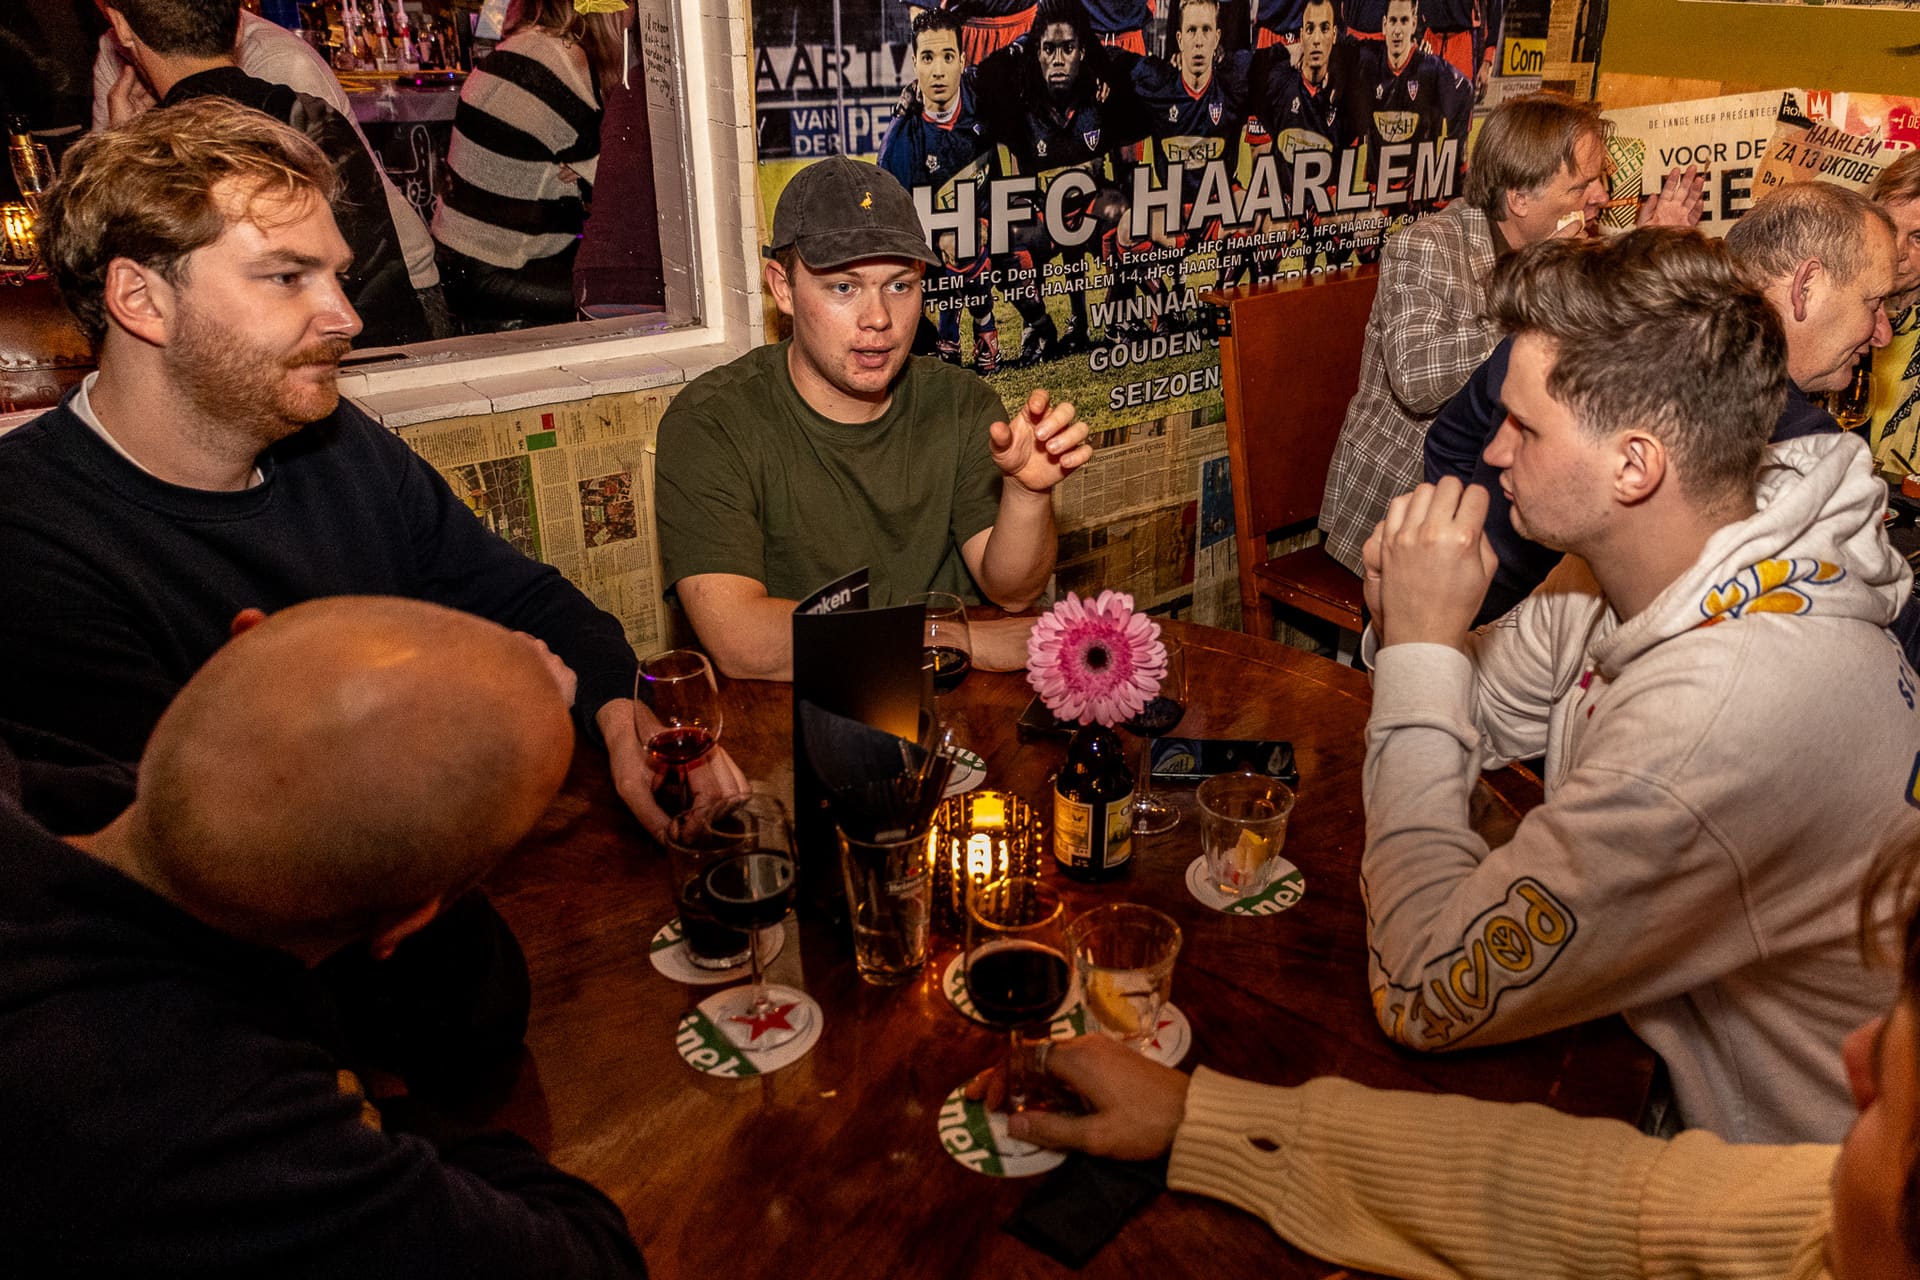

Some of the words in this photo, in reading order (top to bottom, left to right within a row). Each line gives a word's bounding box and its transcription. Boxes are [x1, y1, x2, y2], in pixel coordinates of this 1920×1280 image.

[793, 108, 838, 131] VAN
[1659, 142, 1727, 167] VOOR
[1774, 141, 1797, 164] ZA
[1798, 147, 1821, 169] 13
[1804, 124, 1882, 160] HAARLEM
[912, 170, 1098, 260] HFC
[1131, 138, 1458, 237] HAARLEM
[980, 270, 1002, 286] FC
[1007, 267, 1038, 282] Den
[1042, 257, 1090, 277] Bosch
[1122, 246, 1187, 266] Excelsior
[1197, 239, 1224, 255] HFC
[1226, 230, 1287, 250] HAARLEM
[1313, 224, 1337, 238] HFC
[1340, 215, 1393, 234] HAARLEM
[1401, 213, 1415, 225] Go
[926, 293, 989, 314] Telstar
[1003, 284, 1036, 302] HFC
[1040, 273, 1116, 298] HAARLEM
[1147, 263, 1176, 280] HFC
[1178, 254, 1242, 275] HAARLEM
[1252, 249, 1278, 263] VVV
[1281, 243, 1312, 258] Venlo
[1339, 235, 1380, 251] Fortuna
[1089, 331, 1202, 372] GOUDEN
[1109, 364, 1220, 411] SEIZOEN
[805, 587, 852, 615] nken
